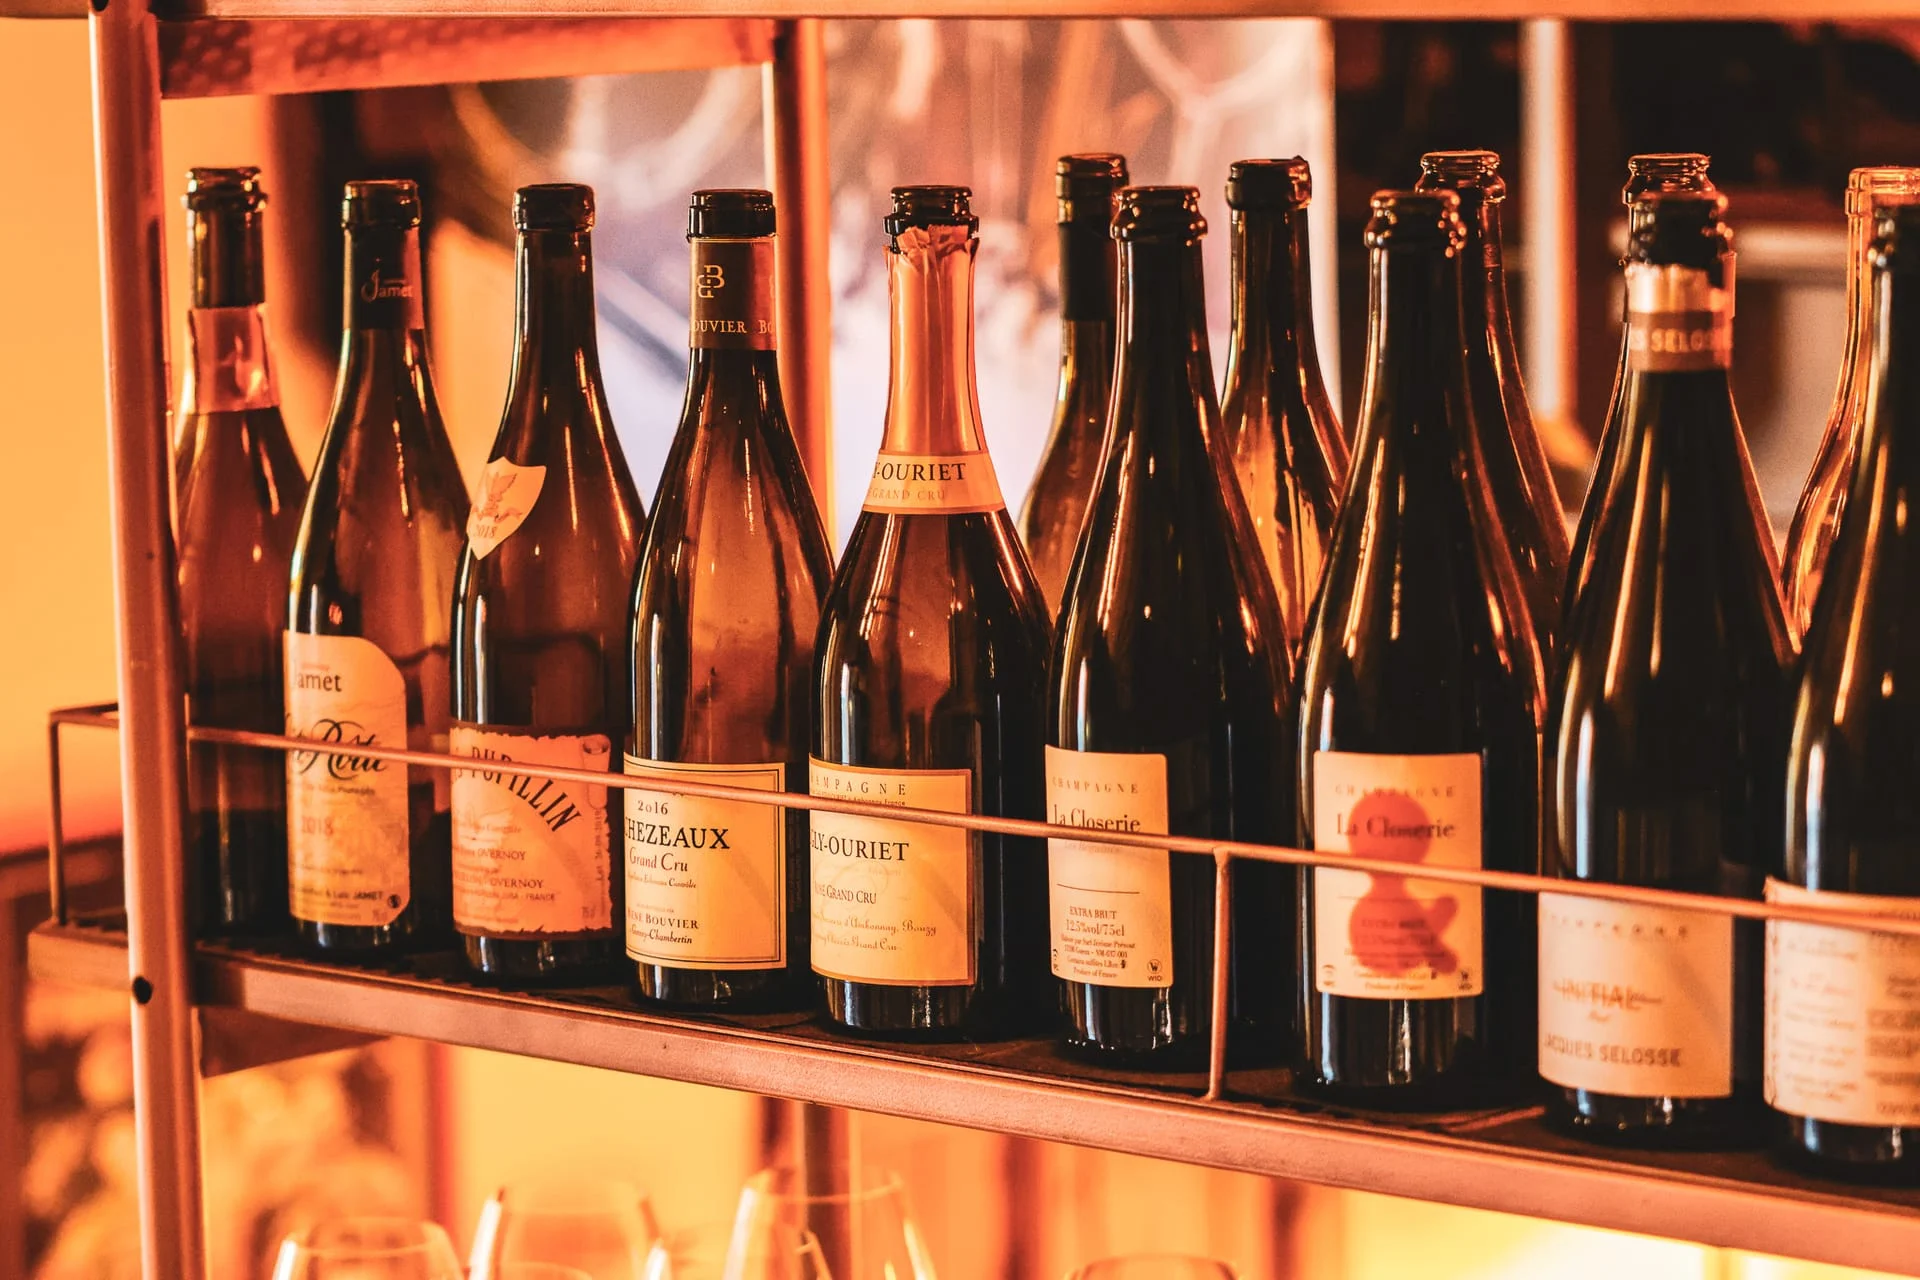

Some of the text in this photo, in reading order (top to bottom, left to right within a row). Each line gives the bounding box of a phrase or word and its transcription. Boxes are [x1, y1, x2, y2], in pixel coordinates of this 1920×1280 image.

[629, 847, 688, 872] Grand Cru
[826, 884, 854, 902] GRAND
[856, 890, 877, 904] CRU
[645, 913, 699, 930] BOUVIER
[1069, 905, 1117, 920] EXTRA BRUT
